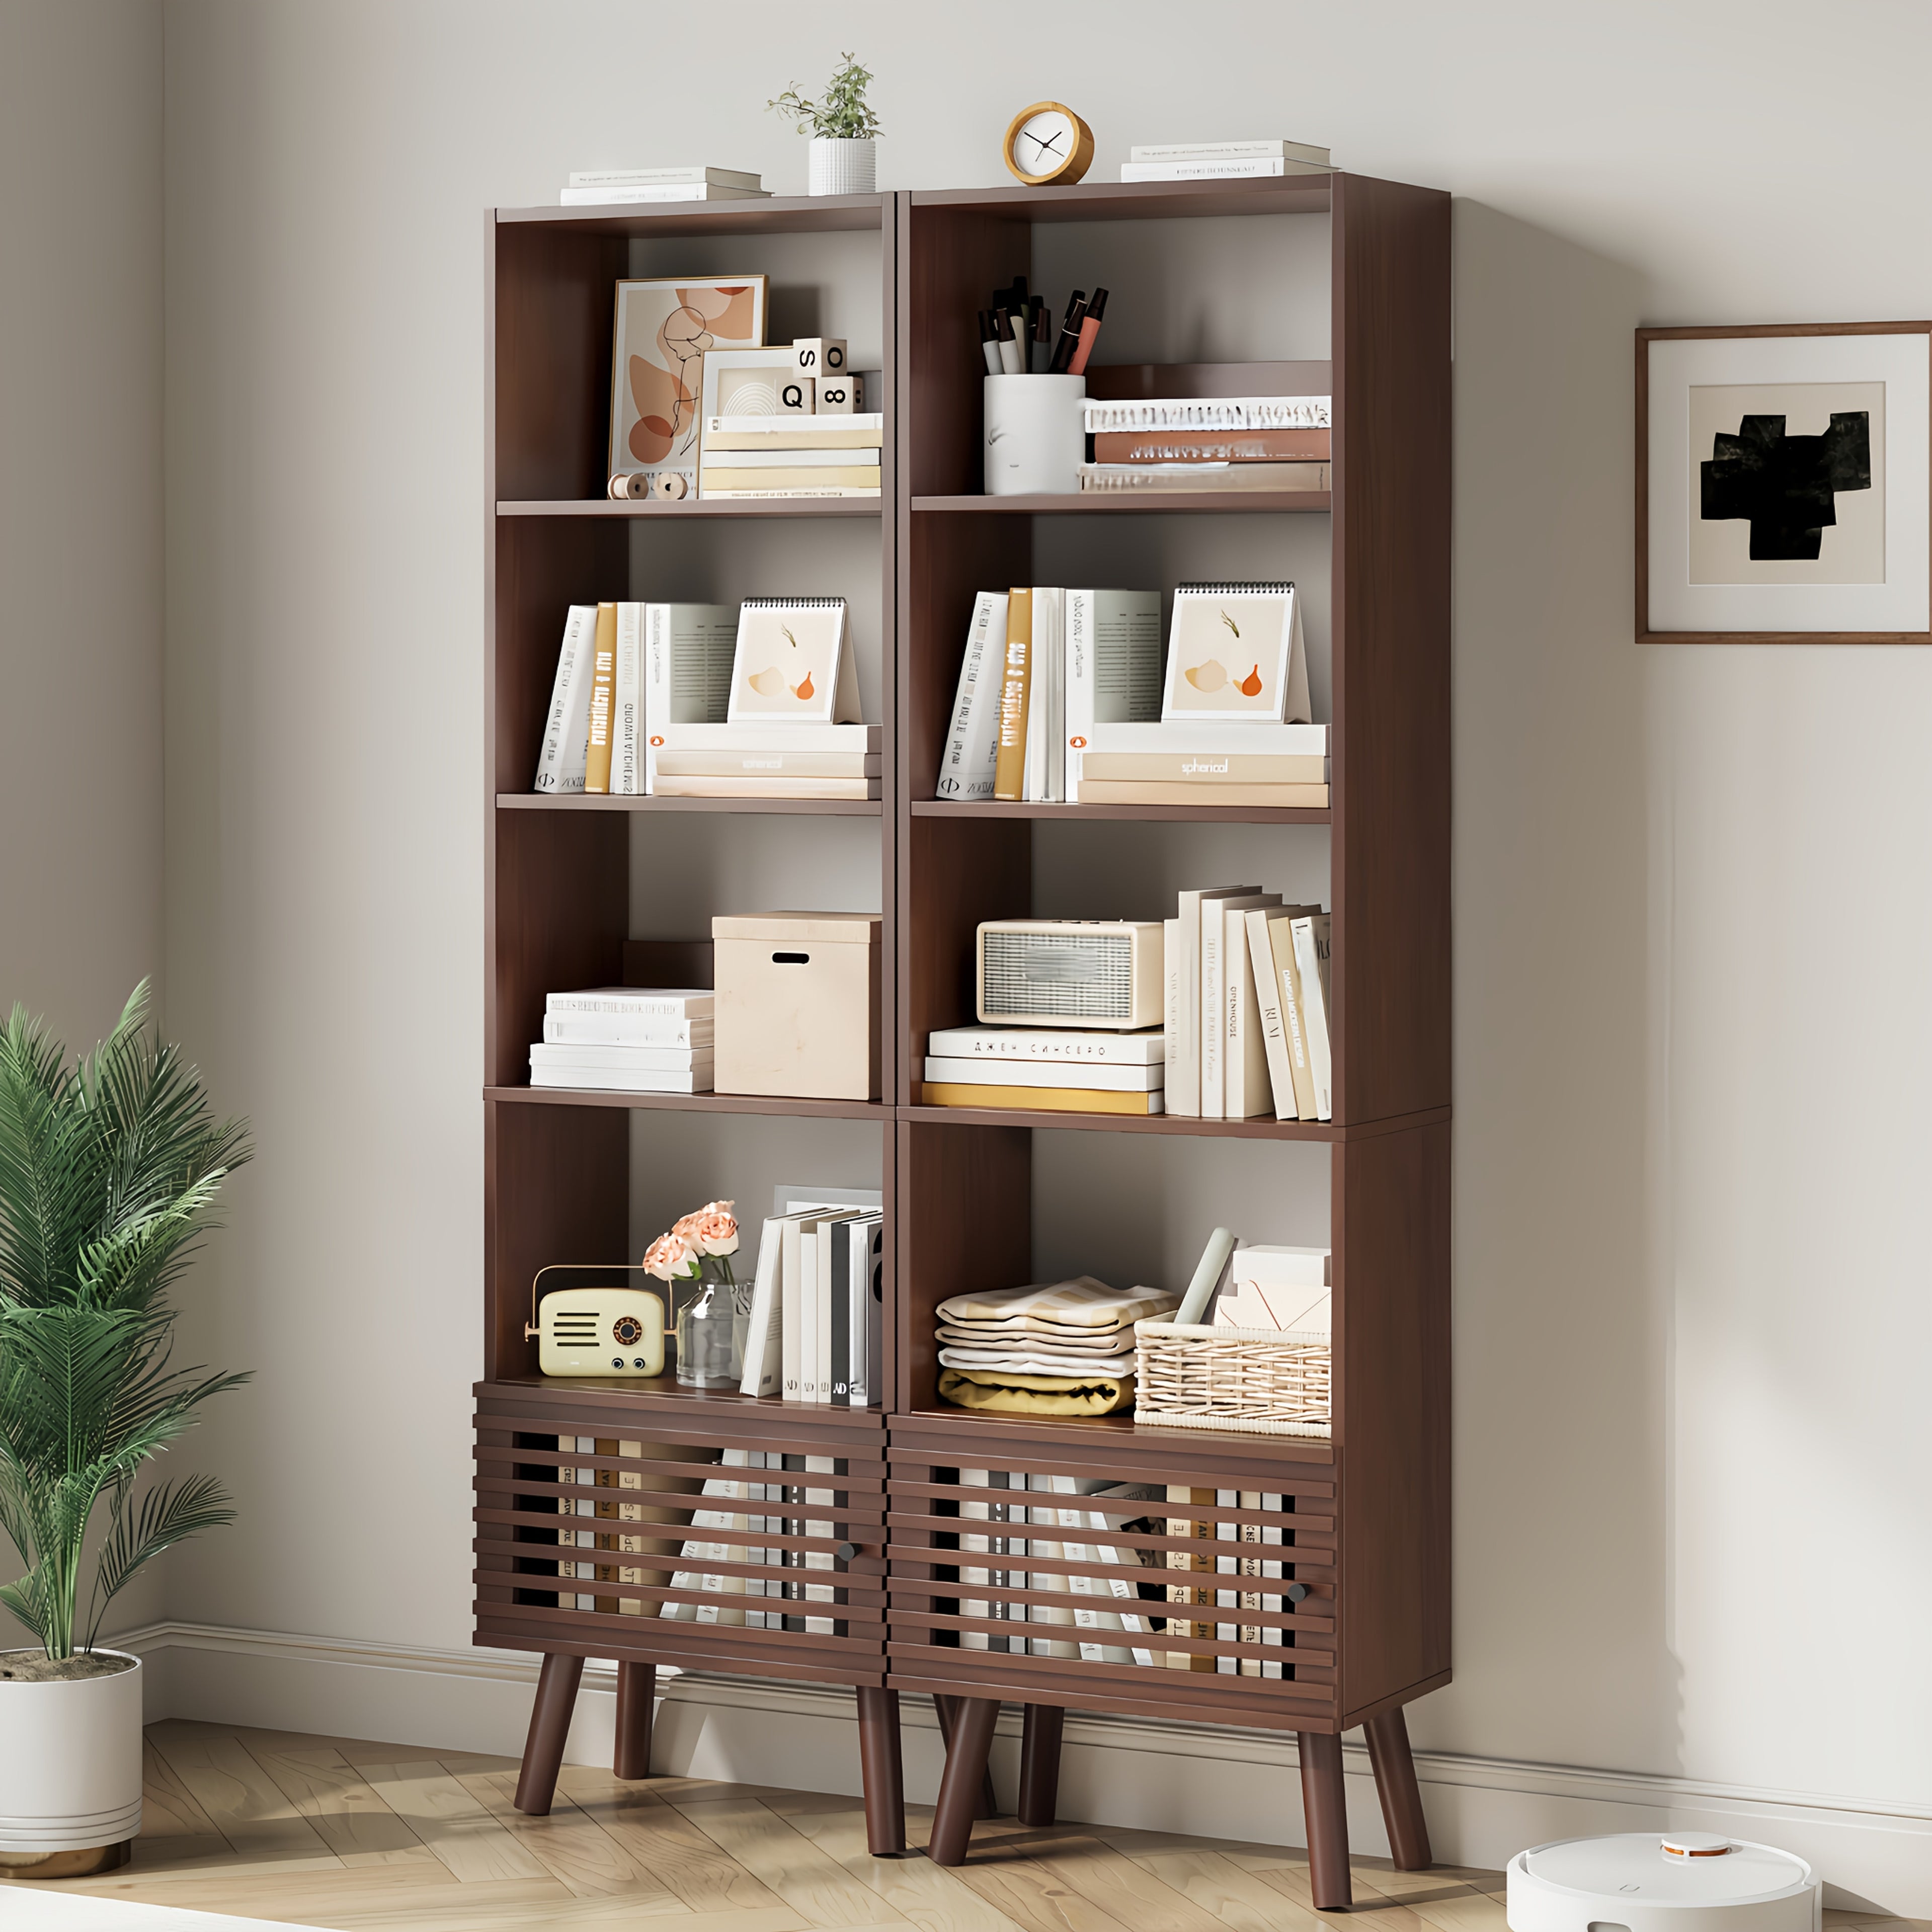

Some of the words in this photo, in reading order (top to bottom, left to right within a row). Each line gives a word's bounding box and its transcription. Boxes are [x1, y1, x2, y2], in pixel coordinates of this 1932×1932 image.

[799, 350, 815, 367] S
[827, 347, 843, 368] O
[782, 385, 802, 409] Q
[825, 389, 846, 404] 8
